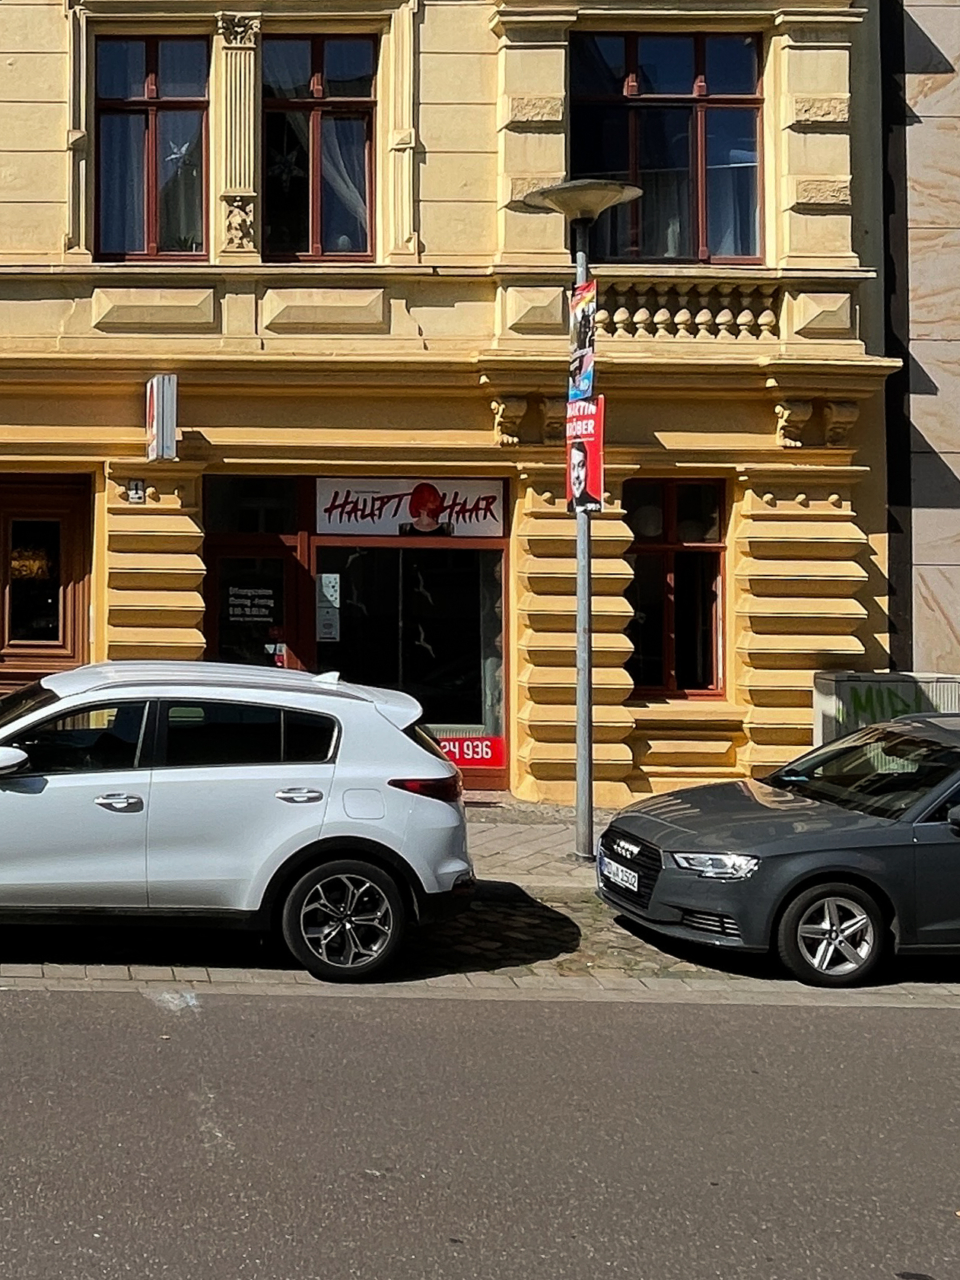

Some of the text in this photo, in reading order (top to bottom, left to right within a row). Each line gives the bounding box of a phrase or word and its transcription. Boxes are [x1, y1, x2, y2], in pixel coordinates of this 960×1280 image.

[324, 489, 500, 524] HAUPT HAAR
[463, 740, 493, 759] 936
